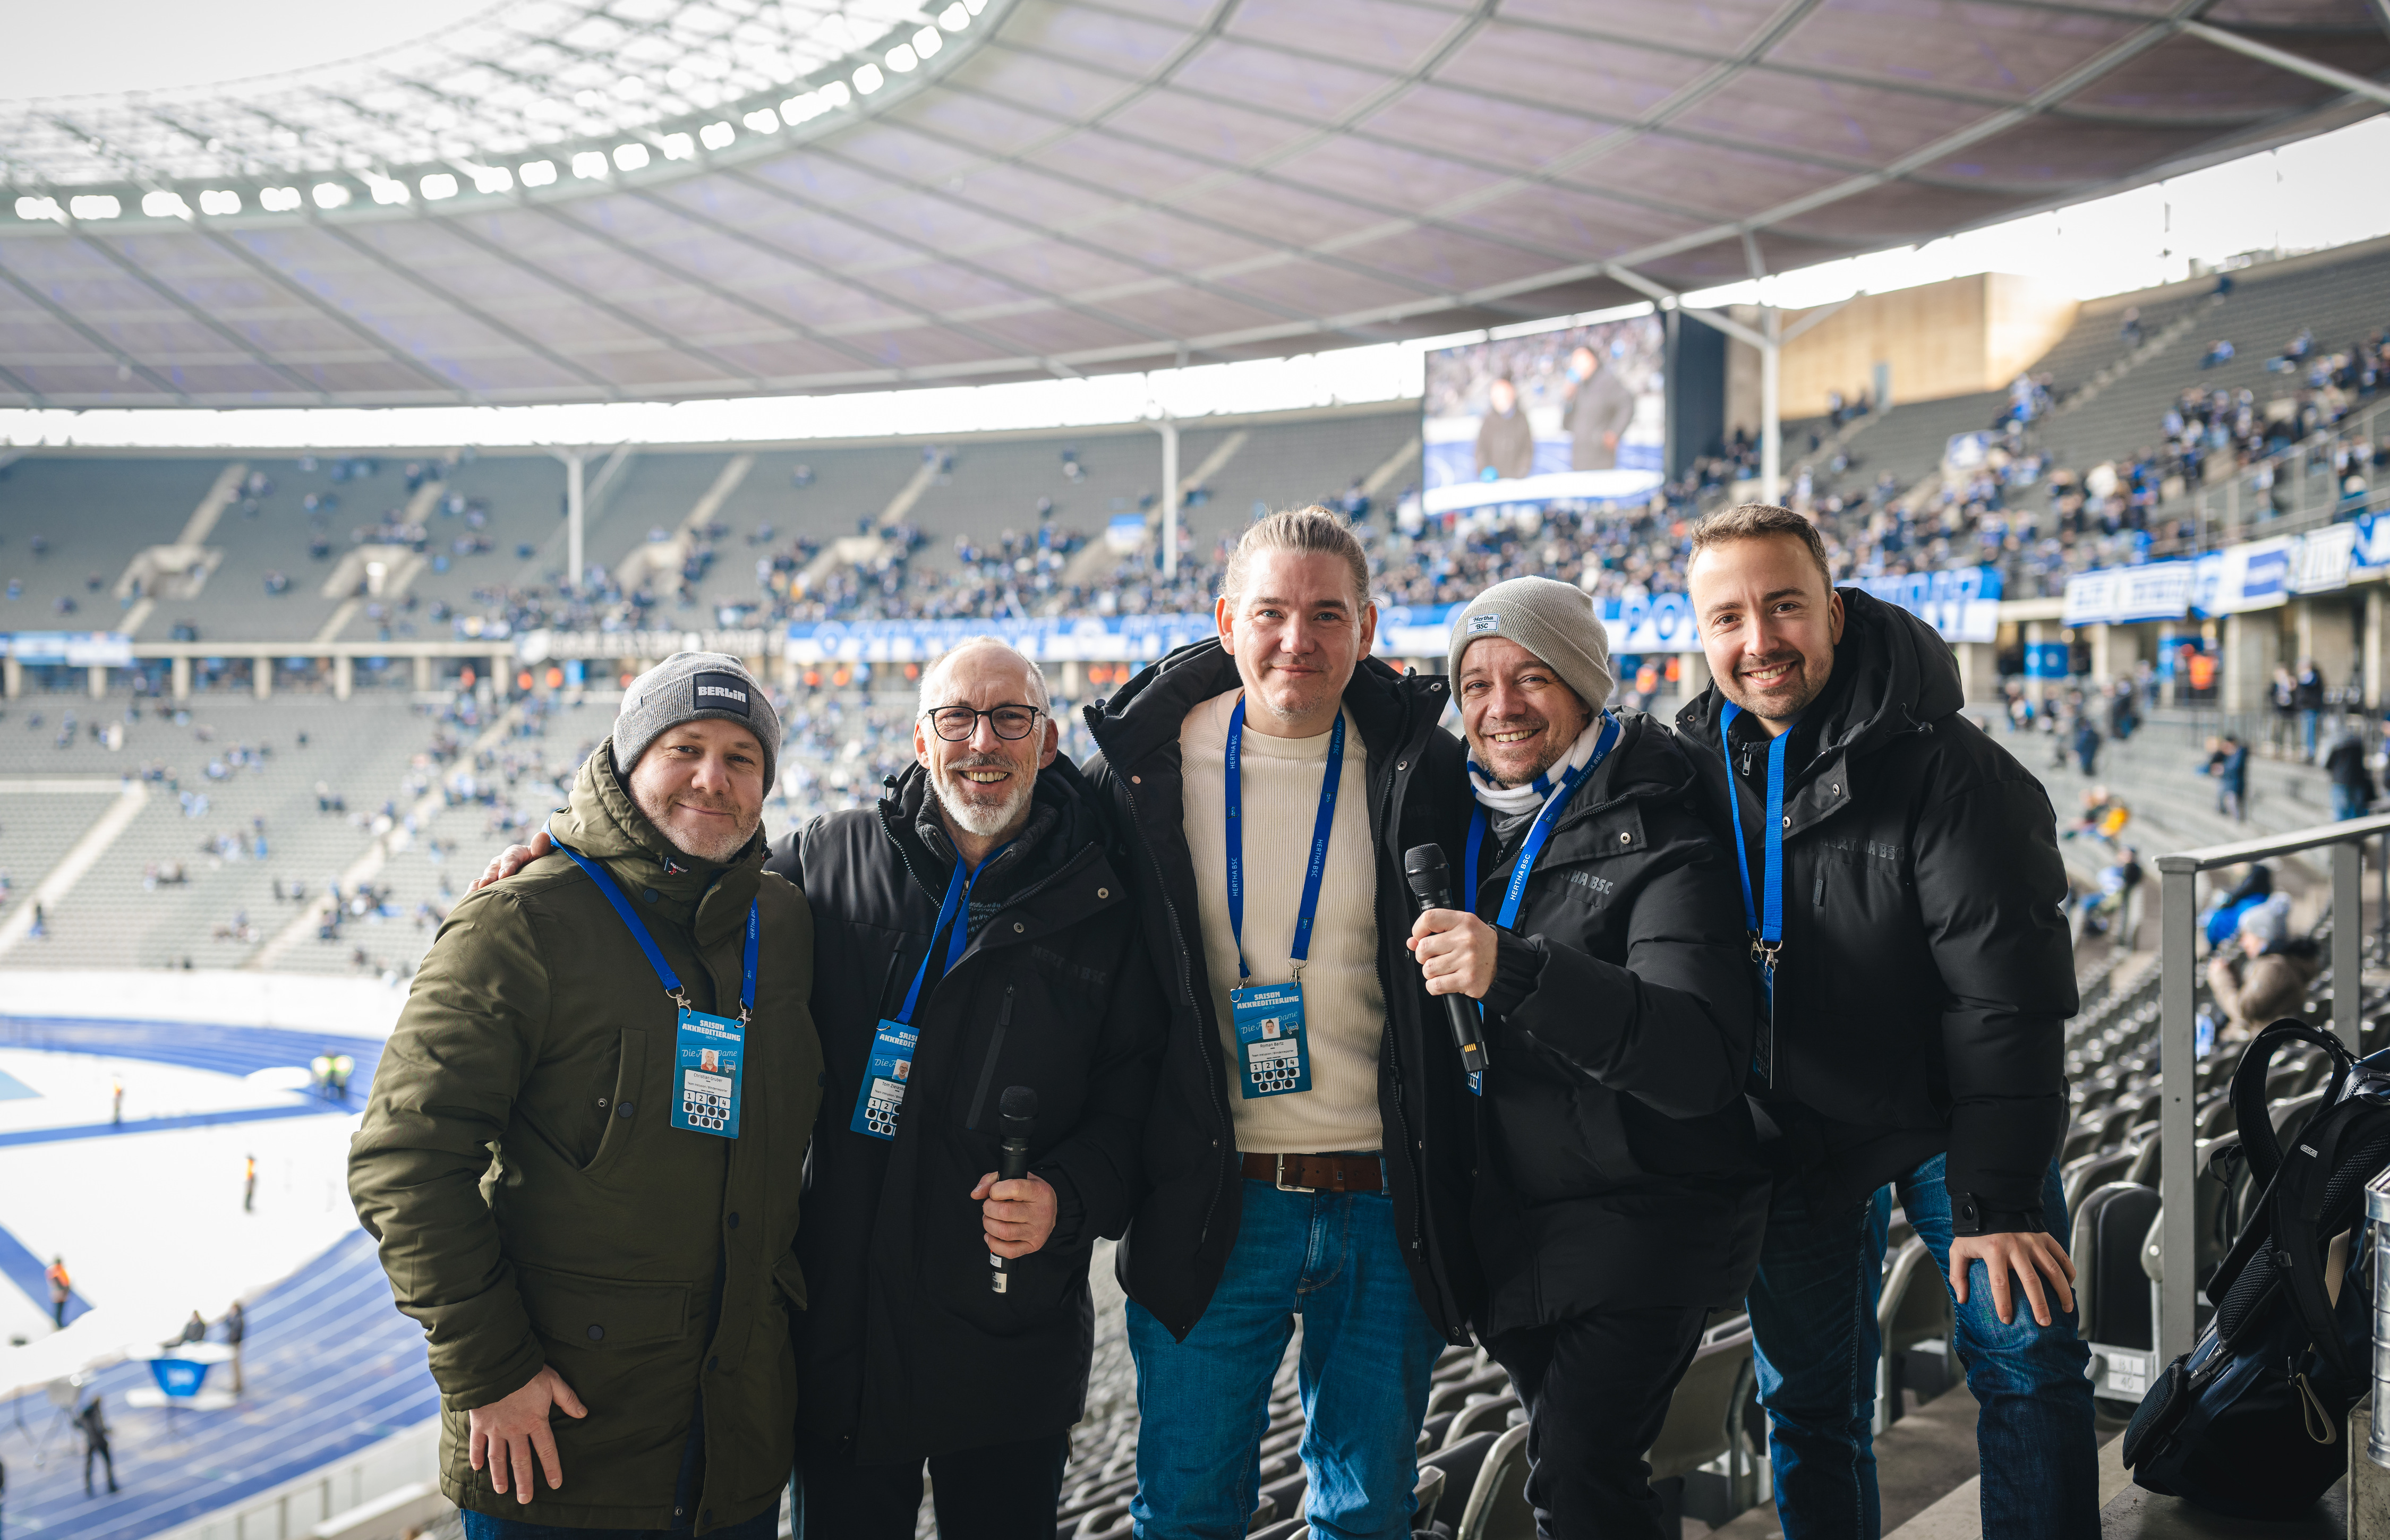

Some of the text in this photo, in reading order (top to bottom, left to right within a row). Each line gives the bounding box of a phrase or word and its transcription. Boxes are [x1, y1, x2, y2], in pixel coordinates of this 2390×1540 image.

[1573, 751, 1603, 789] HERTHA BSC
[1313, 839, 1323, 865] HERTHA
[1509, 853, 1531, 901] HERTHA BSC
[1588, 875, 1614, 895] BSC
[1237, 996, 1299, 1009] AKKREDITIERUNG
[1254, 991, 1281, 1000] SAISON
[682, 1023, 740, 1041] AKKREDITIERUNG
[699, 1020, 724, 1031] SAISON
[1241, 1025, 1255, 1034] Die
